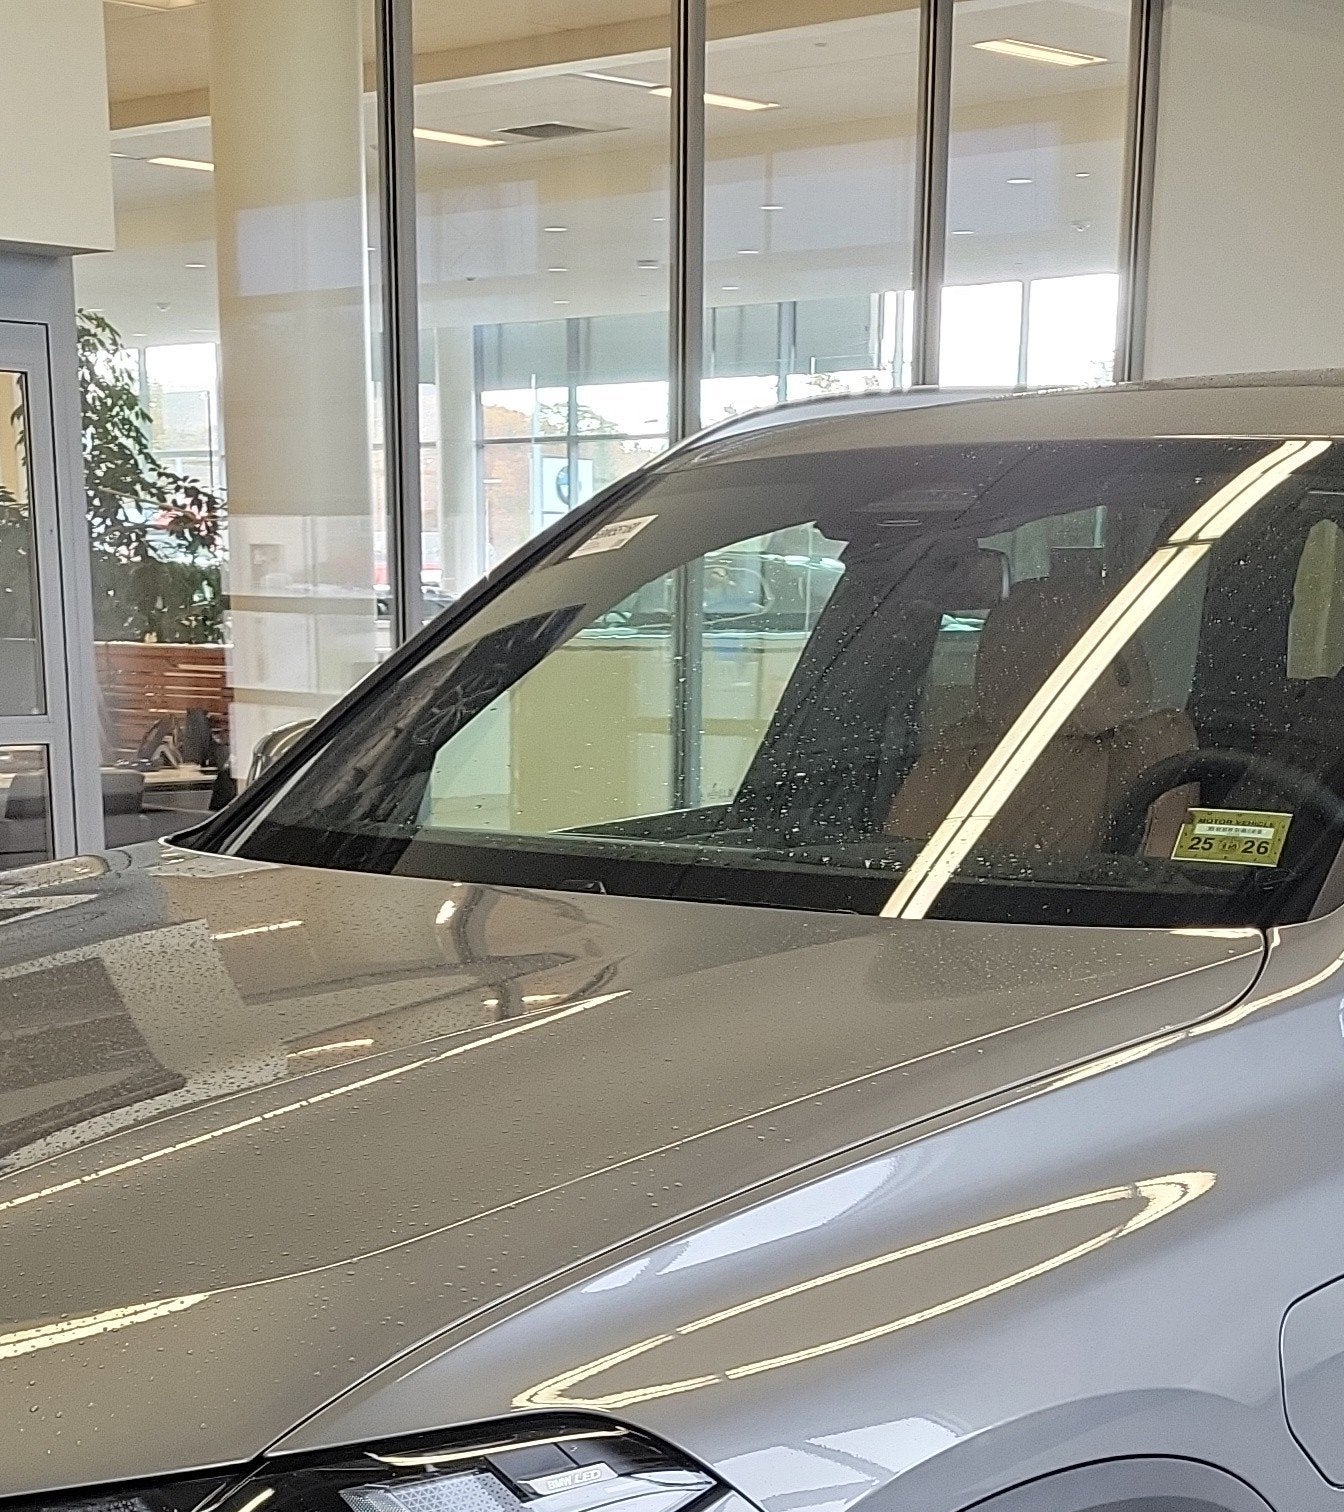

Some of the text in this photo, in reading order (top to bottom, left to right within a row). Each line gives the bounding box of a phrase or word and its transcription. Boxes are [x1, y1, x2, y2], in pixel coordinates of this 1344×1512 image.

[1197, 818, 1233, 826] MOTOR
[1187, 836, 1215, 851] 25
[1240, 839, 1270, 856] 26
[575, 1469, 601, 1484] LED
